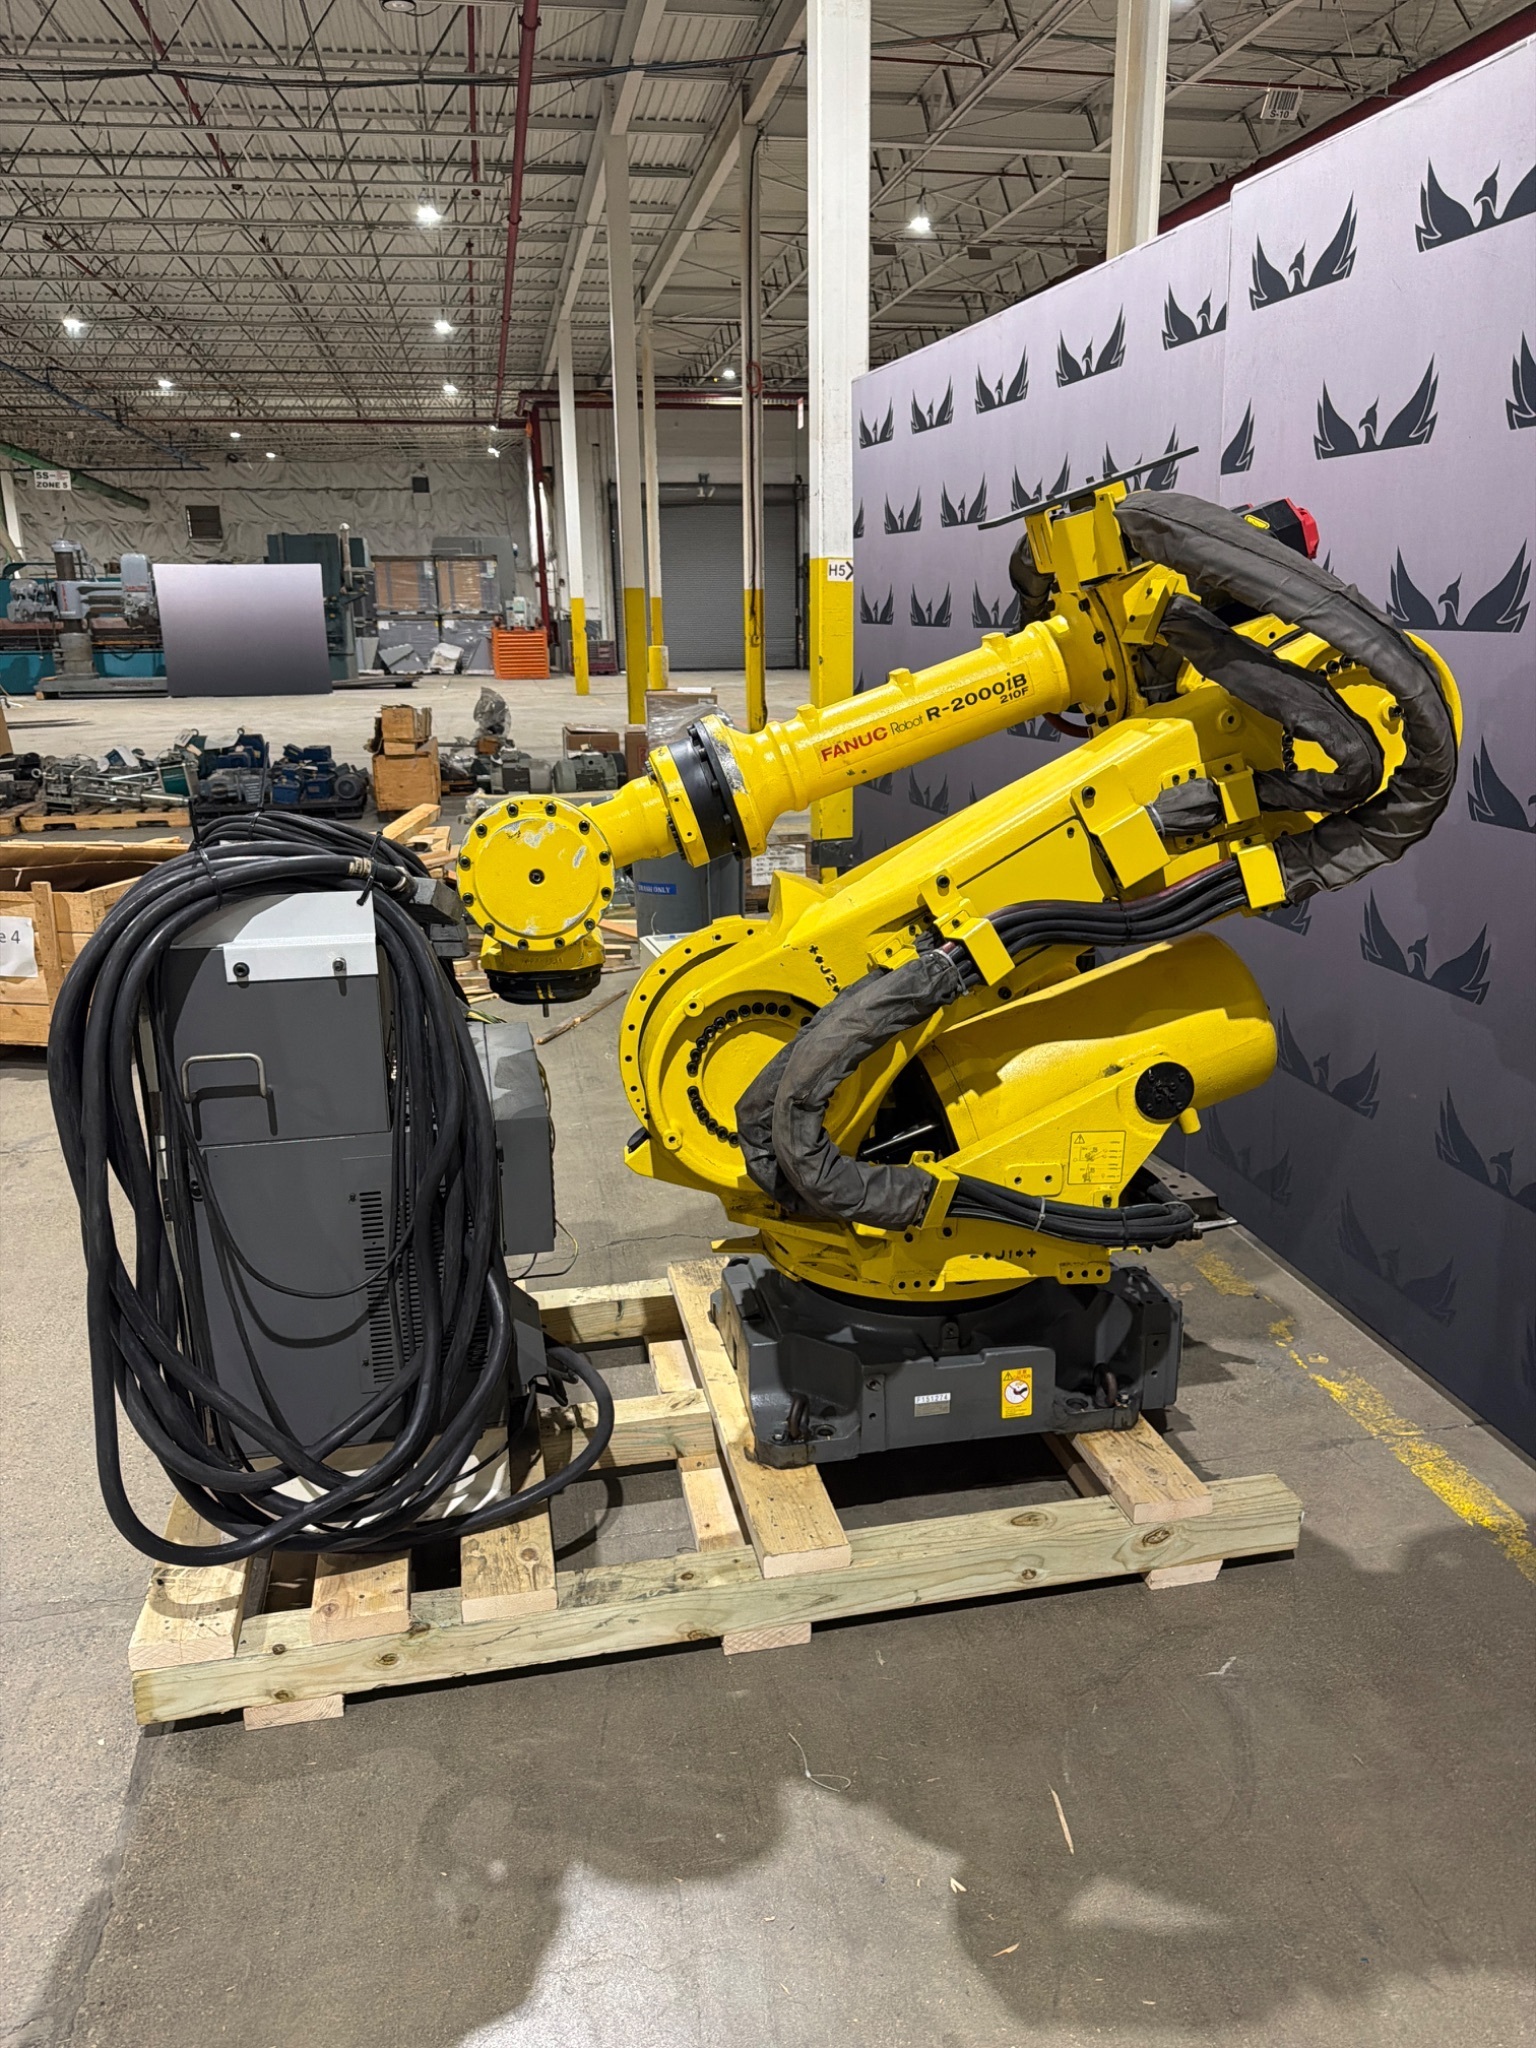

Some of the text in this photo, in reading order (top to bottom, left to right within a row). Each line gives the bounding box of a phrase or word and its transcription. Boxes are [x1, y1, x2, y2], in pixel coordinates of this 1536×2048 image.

[1270, 109, 1290, 119] S-10
[36, 481, 61, 489] ZONE
[697, 486, 716, 498] 17
[828, 564, 846, 577] H5
[1000, 686, 1030, 704] 210F
[821, 672, 1028, 762] FANUC Robot R-2000iB
[653, 886, 671, 894] ONLY
[10, 929, 21, 944] 4
